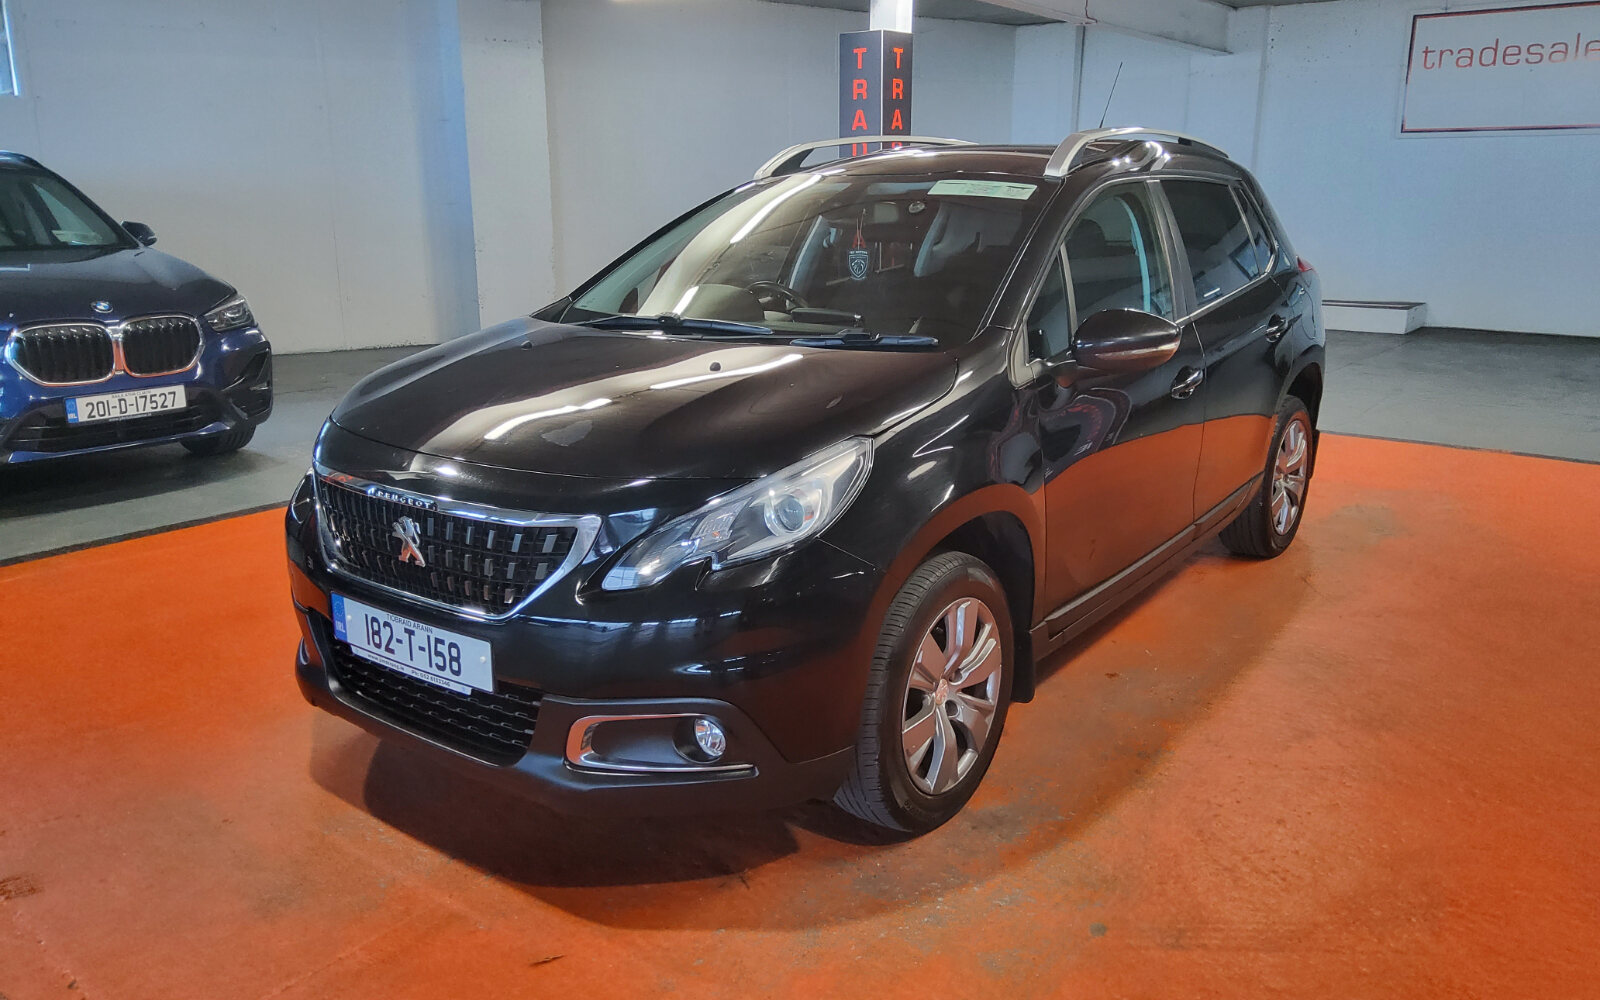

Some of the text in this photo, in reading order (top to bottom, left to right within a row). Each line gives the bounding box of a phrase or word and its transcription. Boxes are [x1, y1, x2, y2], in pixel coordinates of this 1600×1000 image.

[85, 391, 177, 419] 201-D-17527
[376, 489, 431, 509] PEUGEOT
[364, 613, 462, 677] 182-T-158
